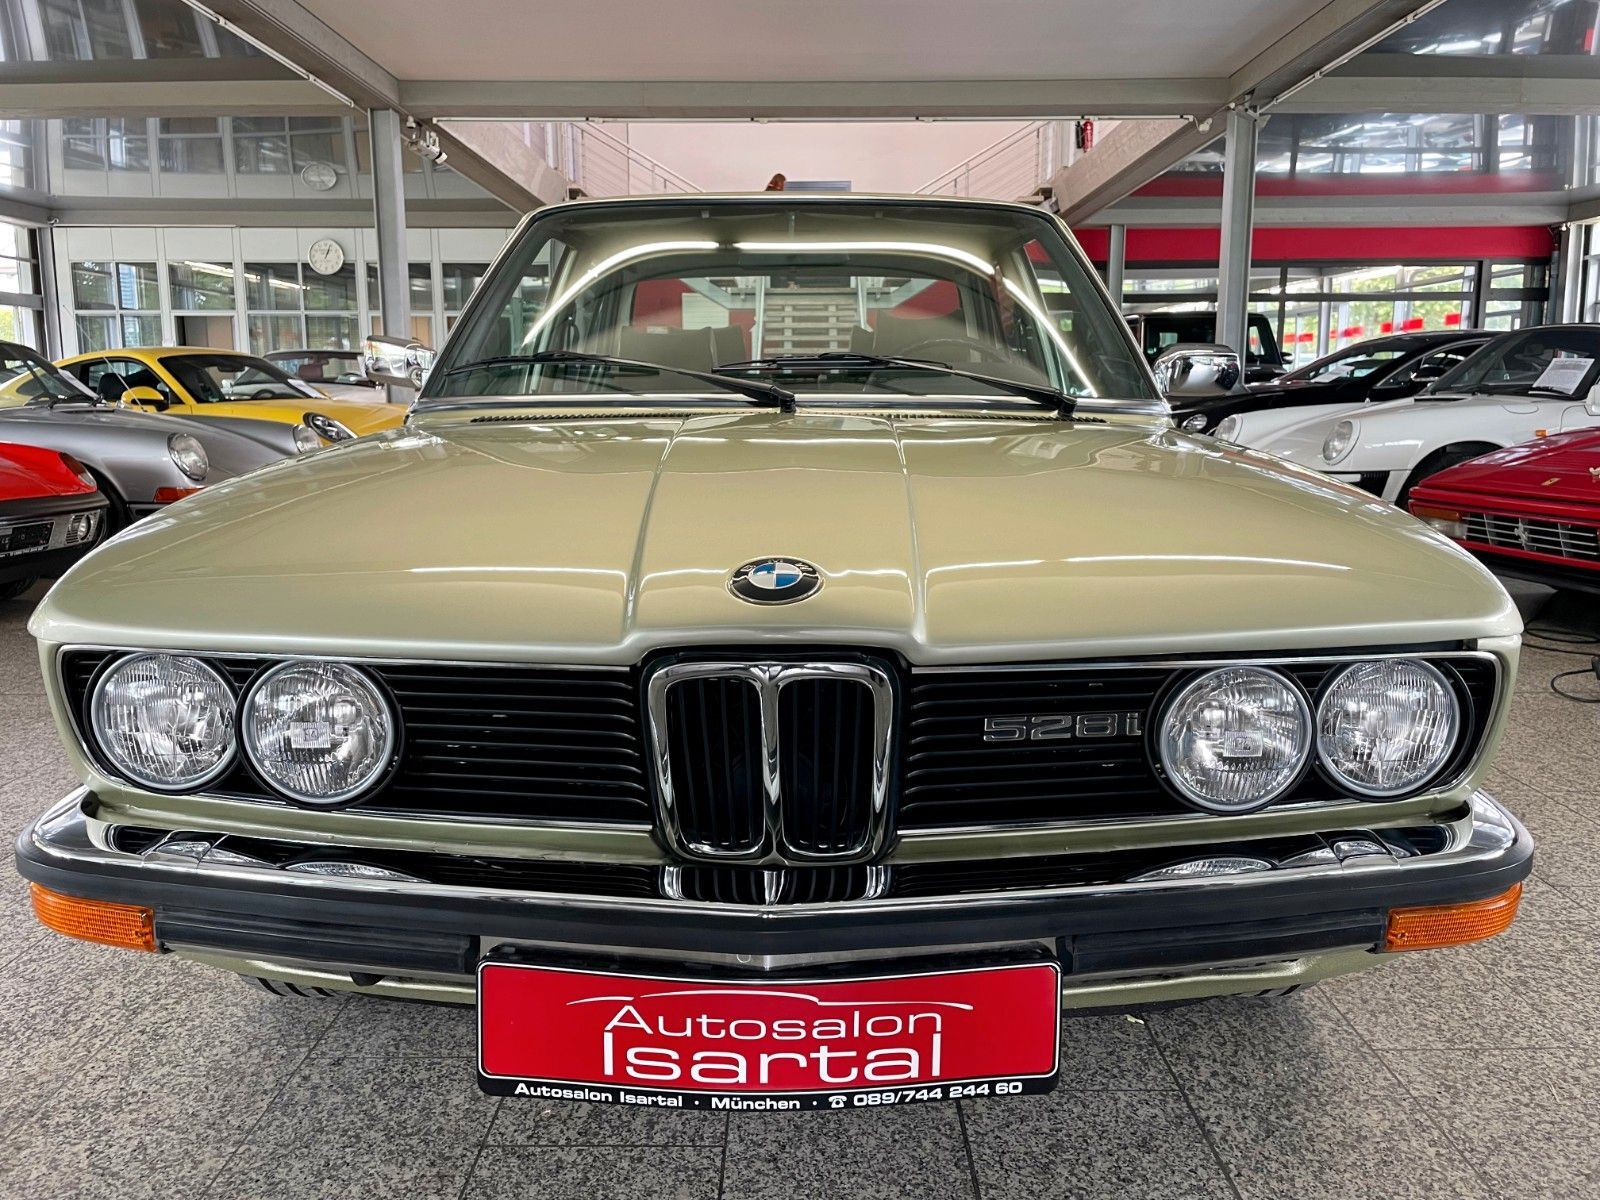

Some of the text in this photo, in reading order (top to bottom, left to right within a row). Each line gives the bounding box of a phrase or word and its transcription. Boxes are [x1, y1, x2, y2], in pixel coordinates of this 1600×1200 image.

[983, 712, 1142, 742] 528i
[604, 1004, 942, 1040] Autosalon
[603, 1031, 942, 1084] Isartal
[514, 1081, 1023, 1110] Autosalon Isartal München 089/744 244 60
